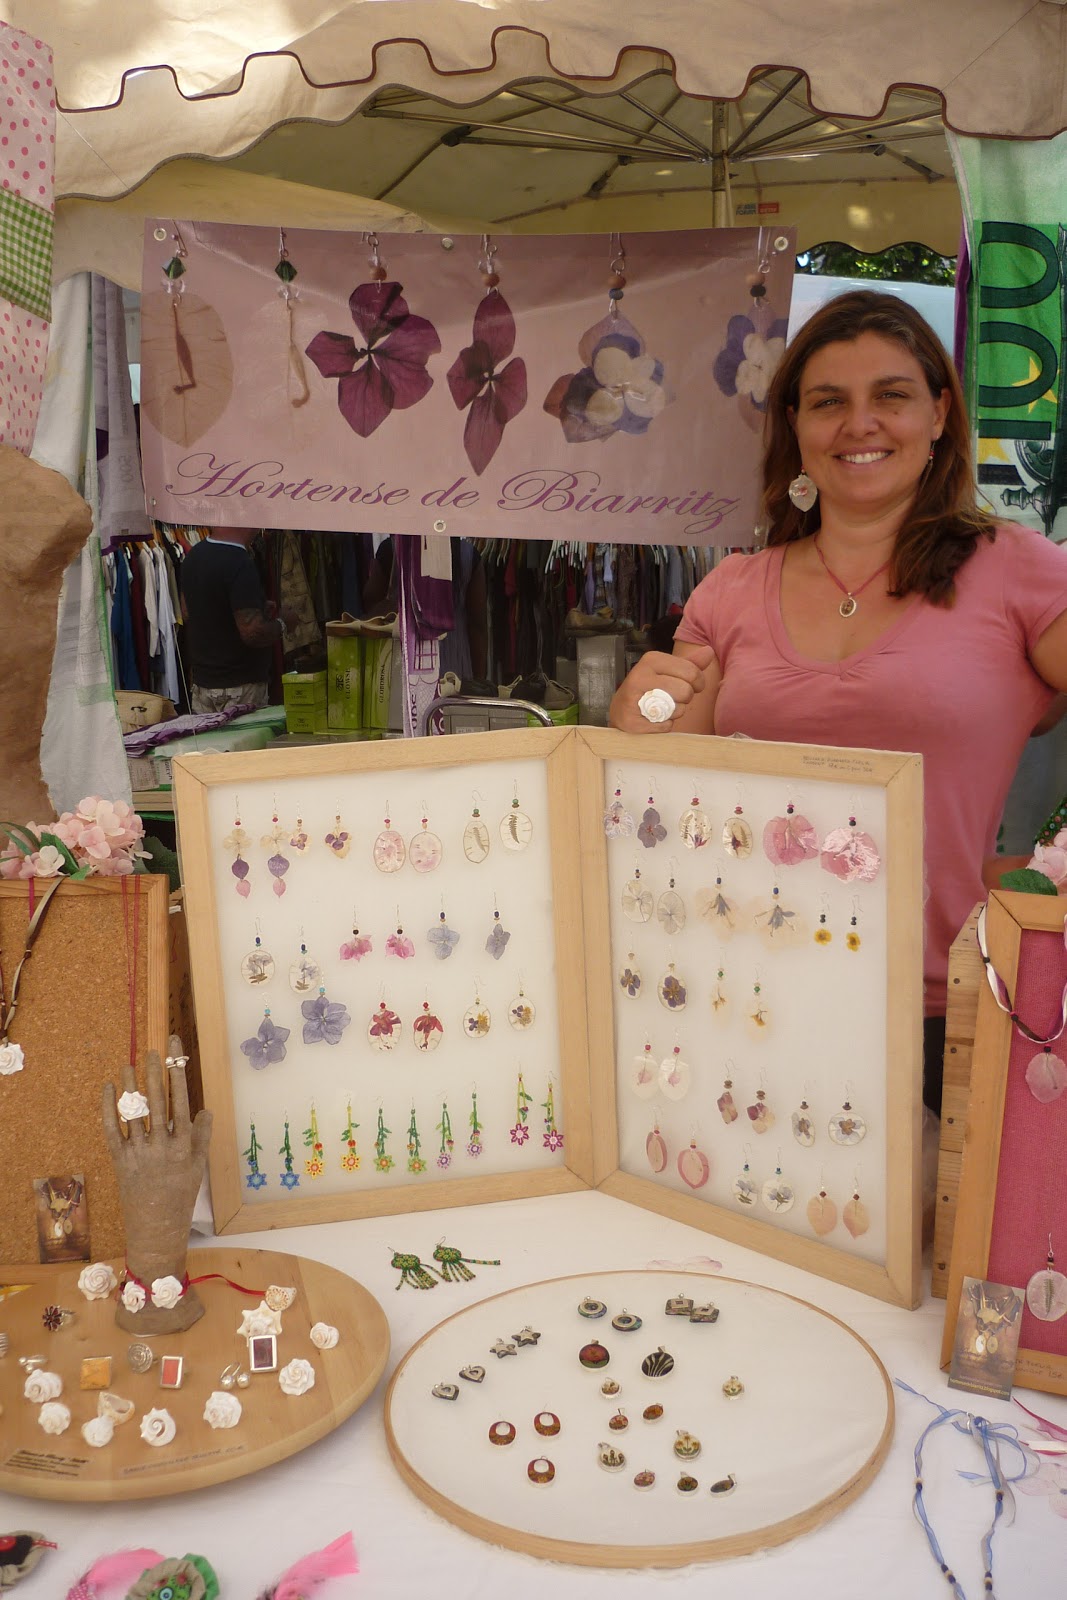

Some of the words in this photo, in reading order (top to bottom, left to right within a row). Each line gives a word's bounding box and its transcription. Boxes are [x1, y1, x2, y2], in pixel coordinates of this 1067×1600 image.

[165, 452, 410, 509] Hortense
[421, 476, 480, 509] de
[498, 469, 741, 535] Biarritz
